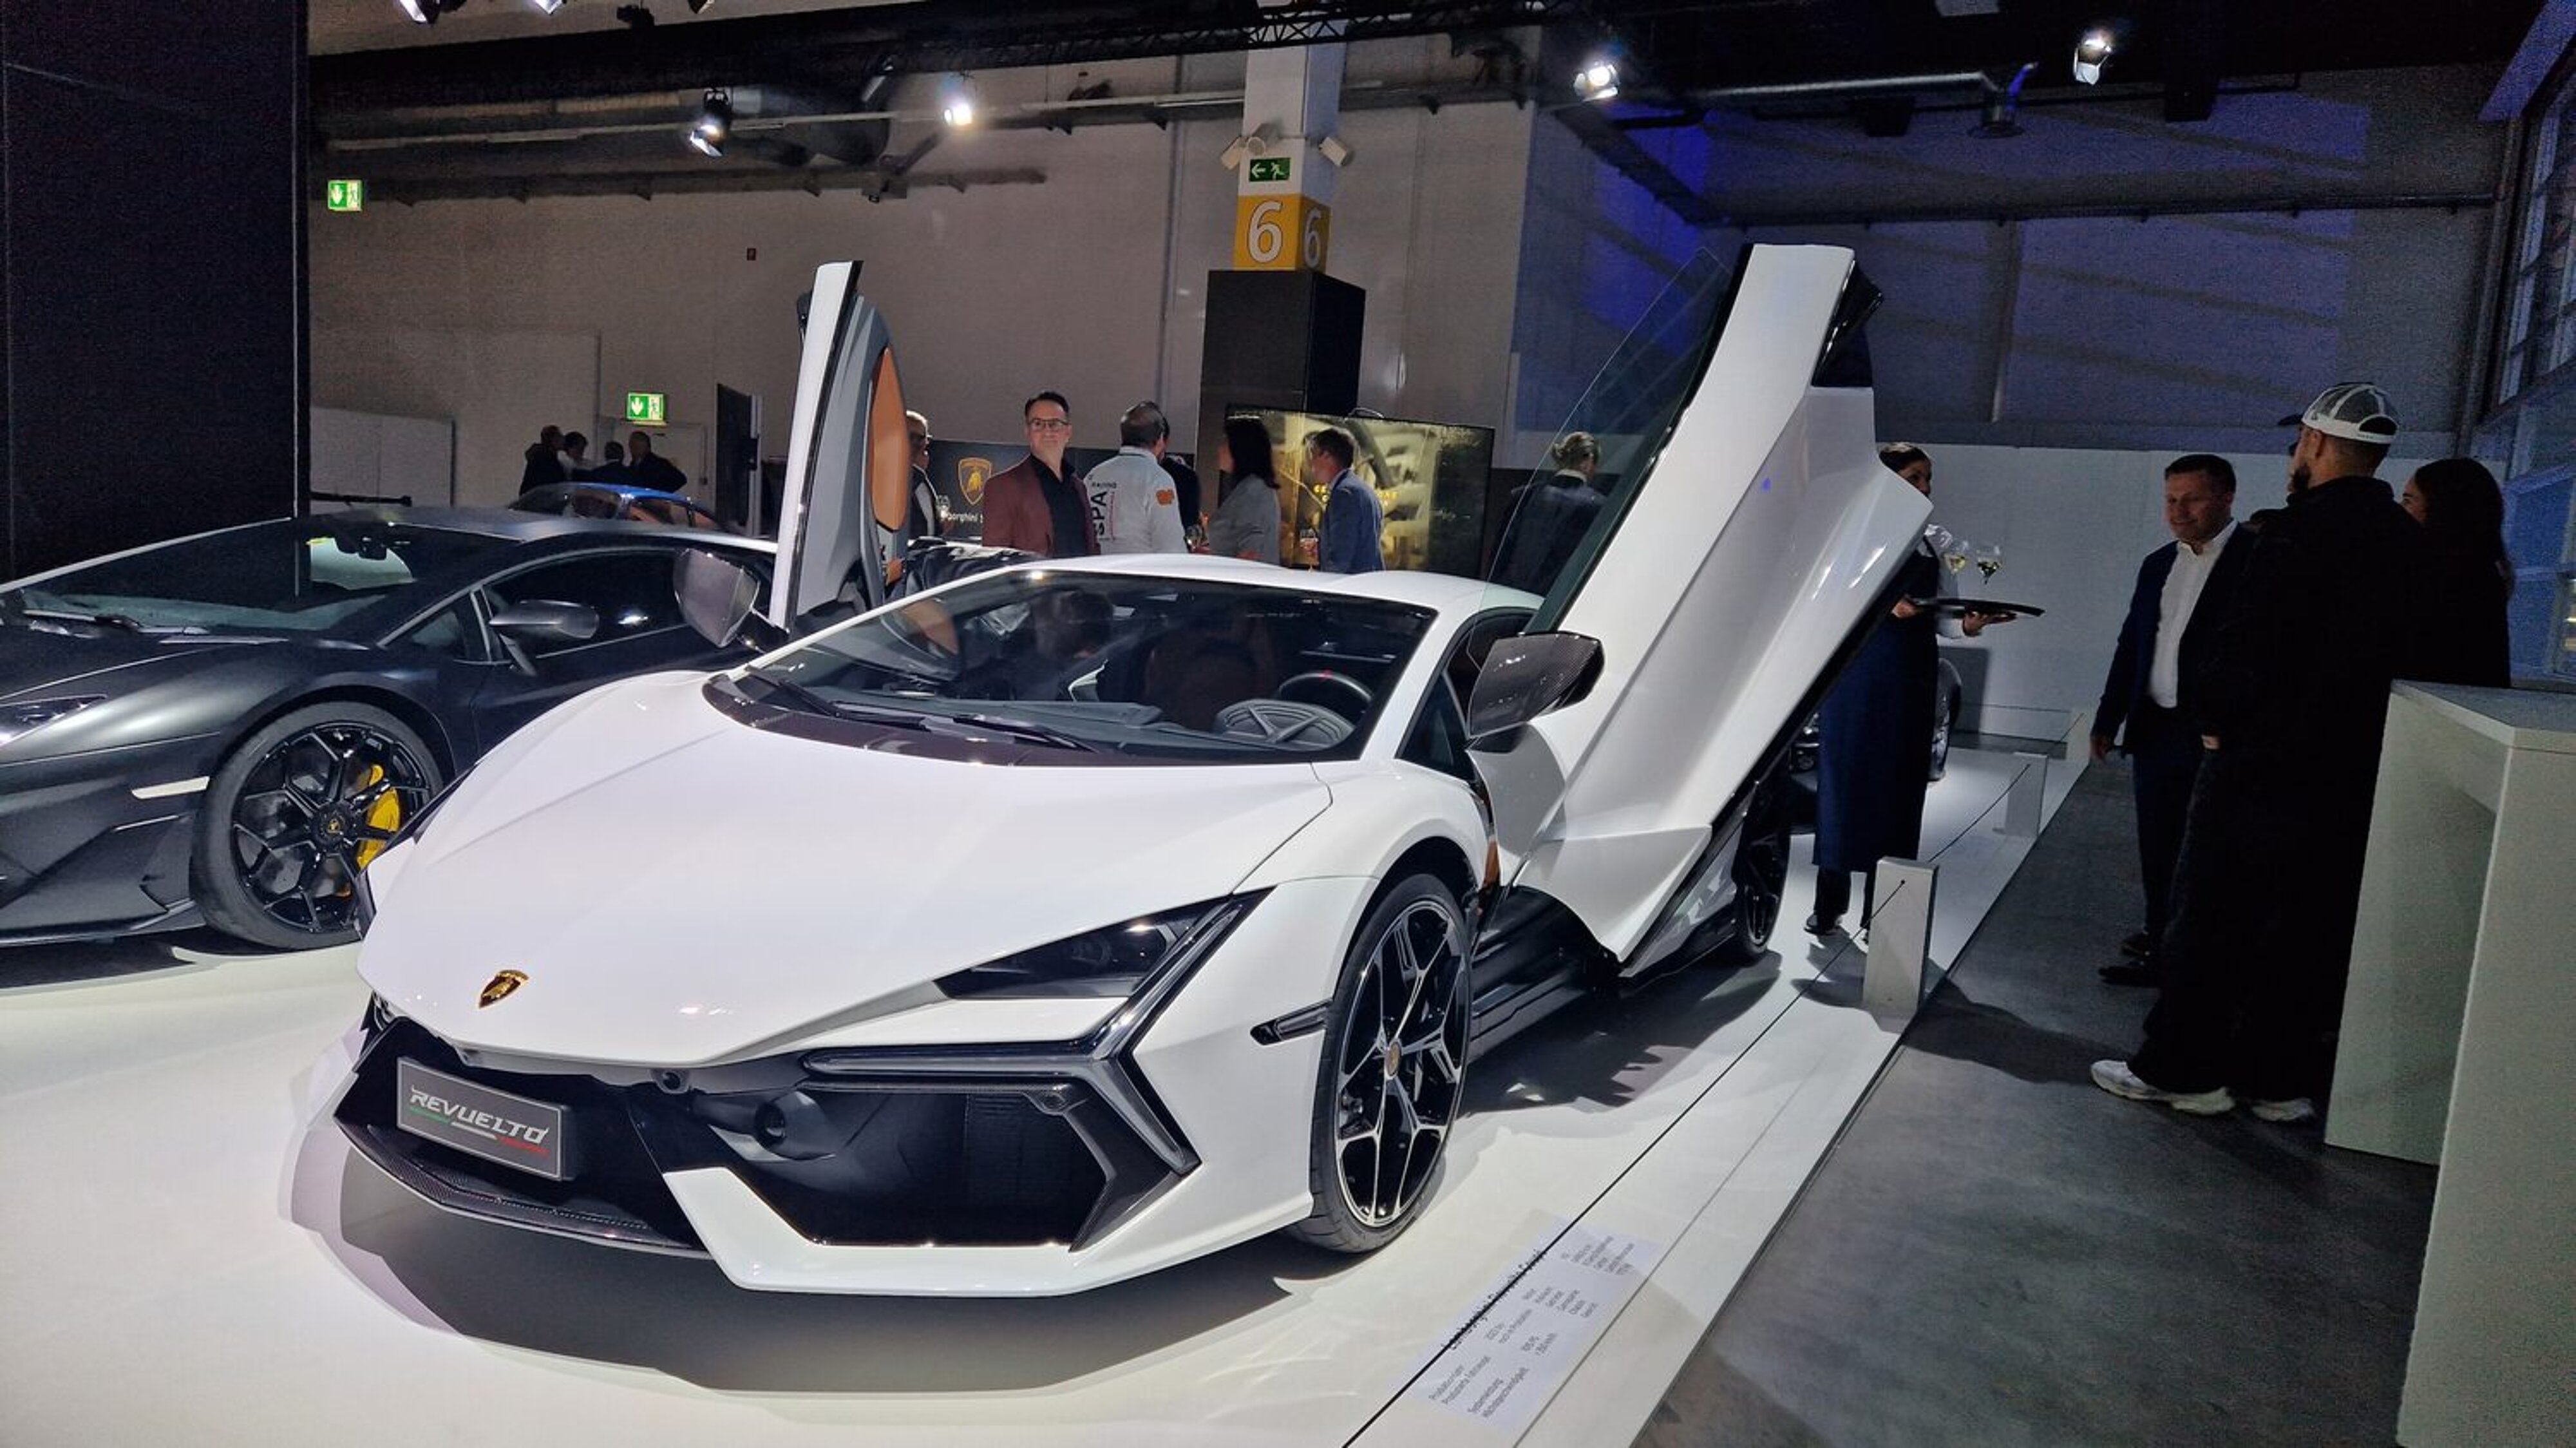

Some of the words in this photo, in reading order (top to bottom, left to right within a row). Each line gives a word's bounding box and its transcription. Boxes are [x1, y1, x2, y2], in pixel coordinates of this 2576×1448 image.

[1248, 201, 1283, 263] 6
[1305, 208, 1321, 268] 6
[410, 1085, 549, 1143] REVUELTO
